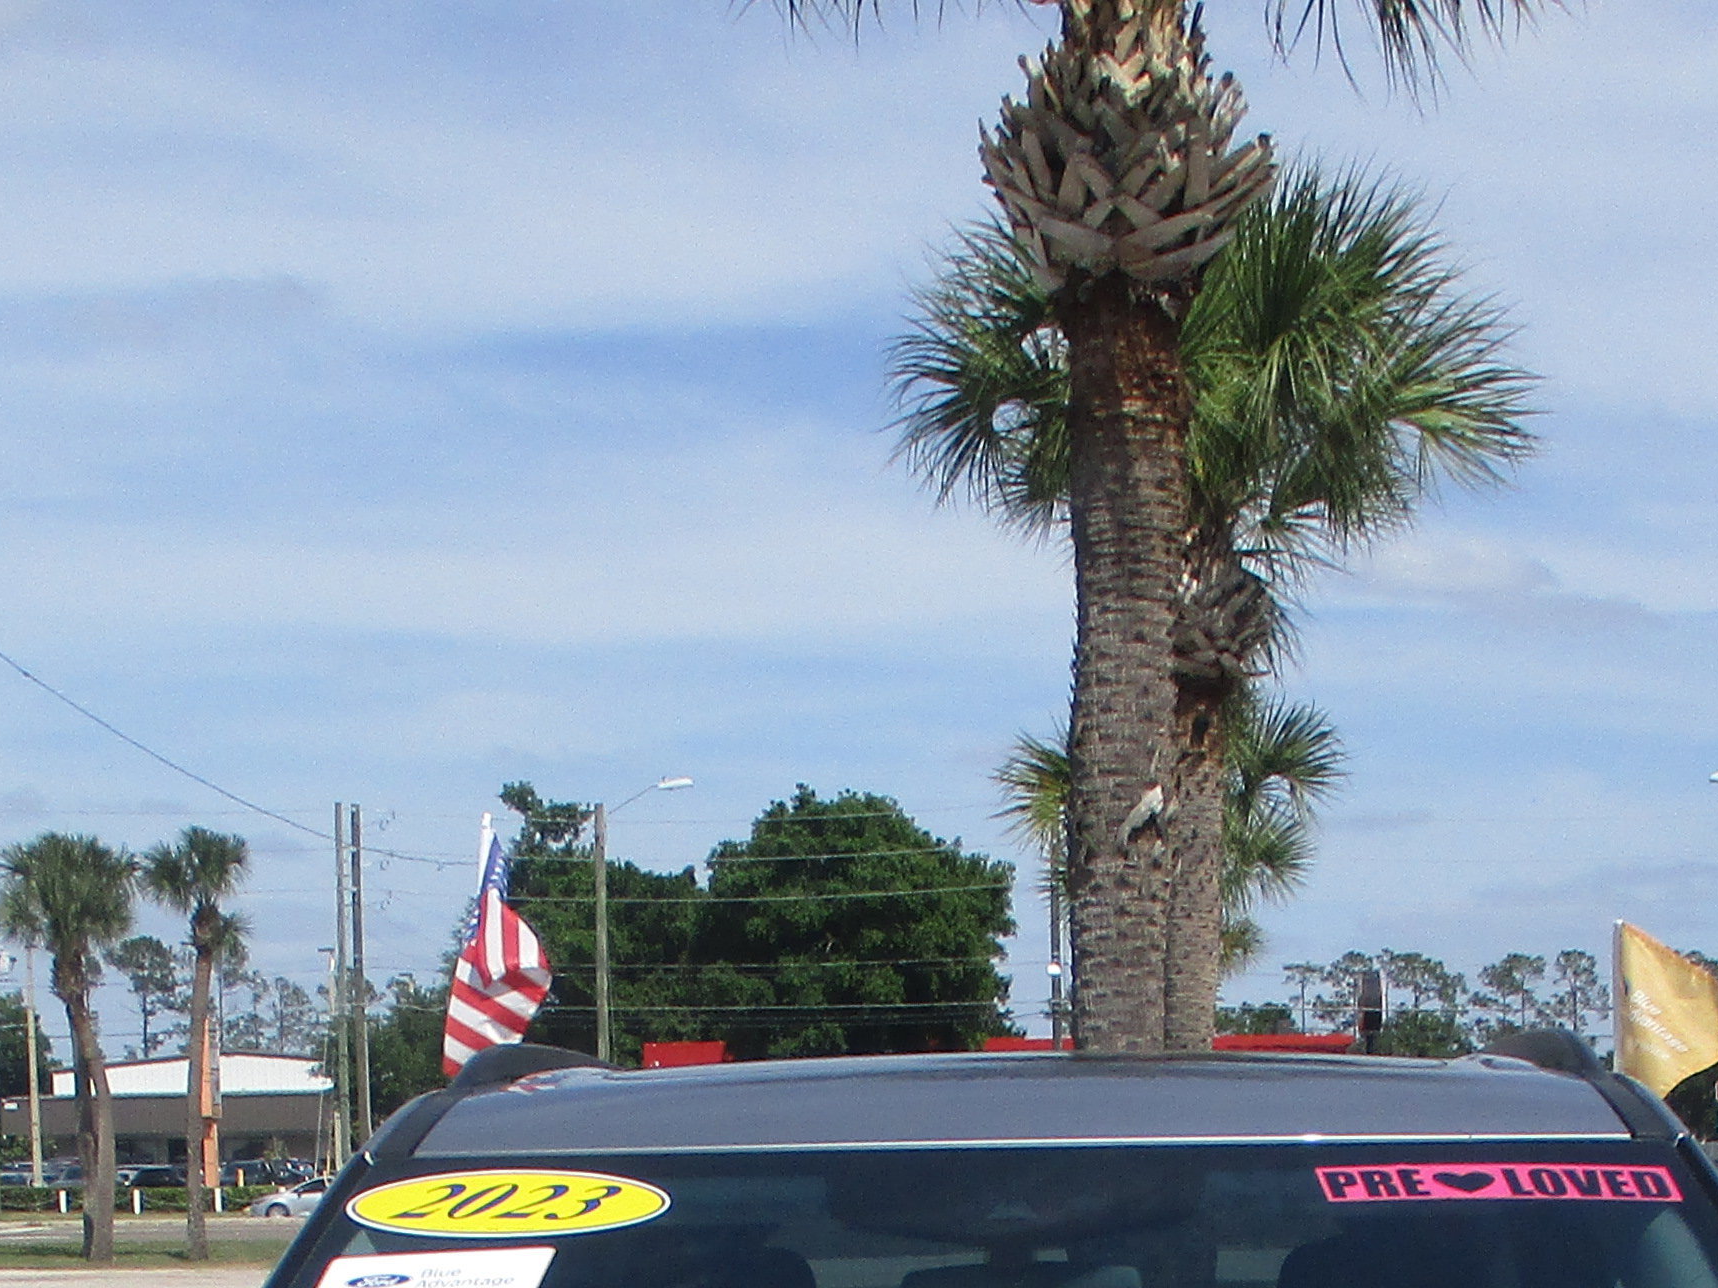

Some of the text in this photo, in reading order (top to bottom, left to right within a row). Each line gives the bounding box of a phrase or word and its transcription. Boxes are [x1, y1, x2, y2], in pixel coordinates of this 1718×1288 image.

[1322, 1168, 1672, 1200] PRE LOVED
[387, 1183, 623, 1220] 2023
[421, 1268, 462, 1278] Blue
[356, 1276, 401, 1287] Ford
[415, 1276, 515, 1288] Advantage
